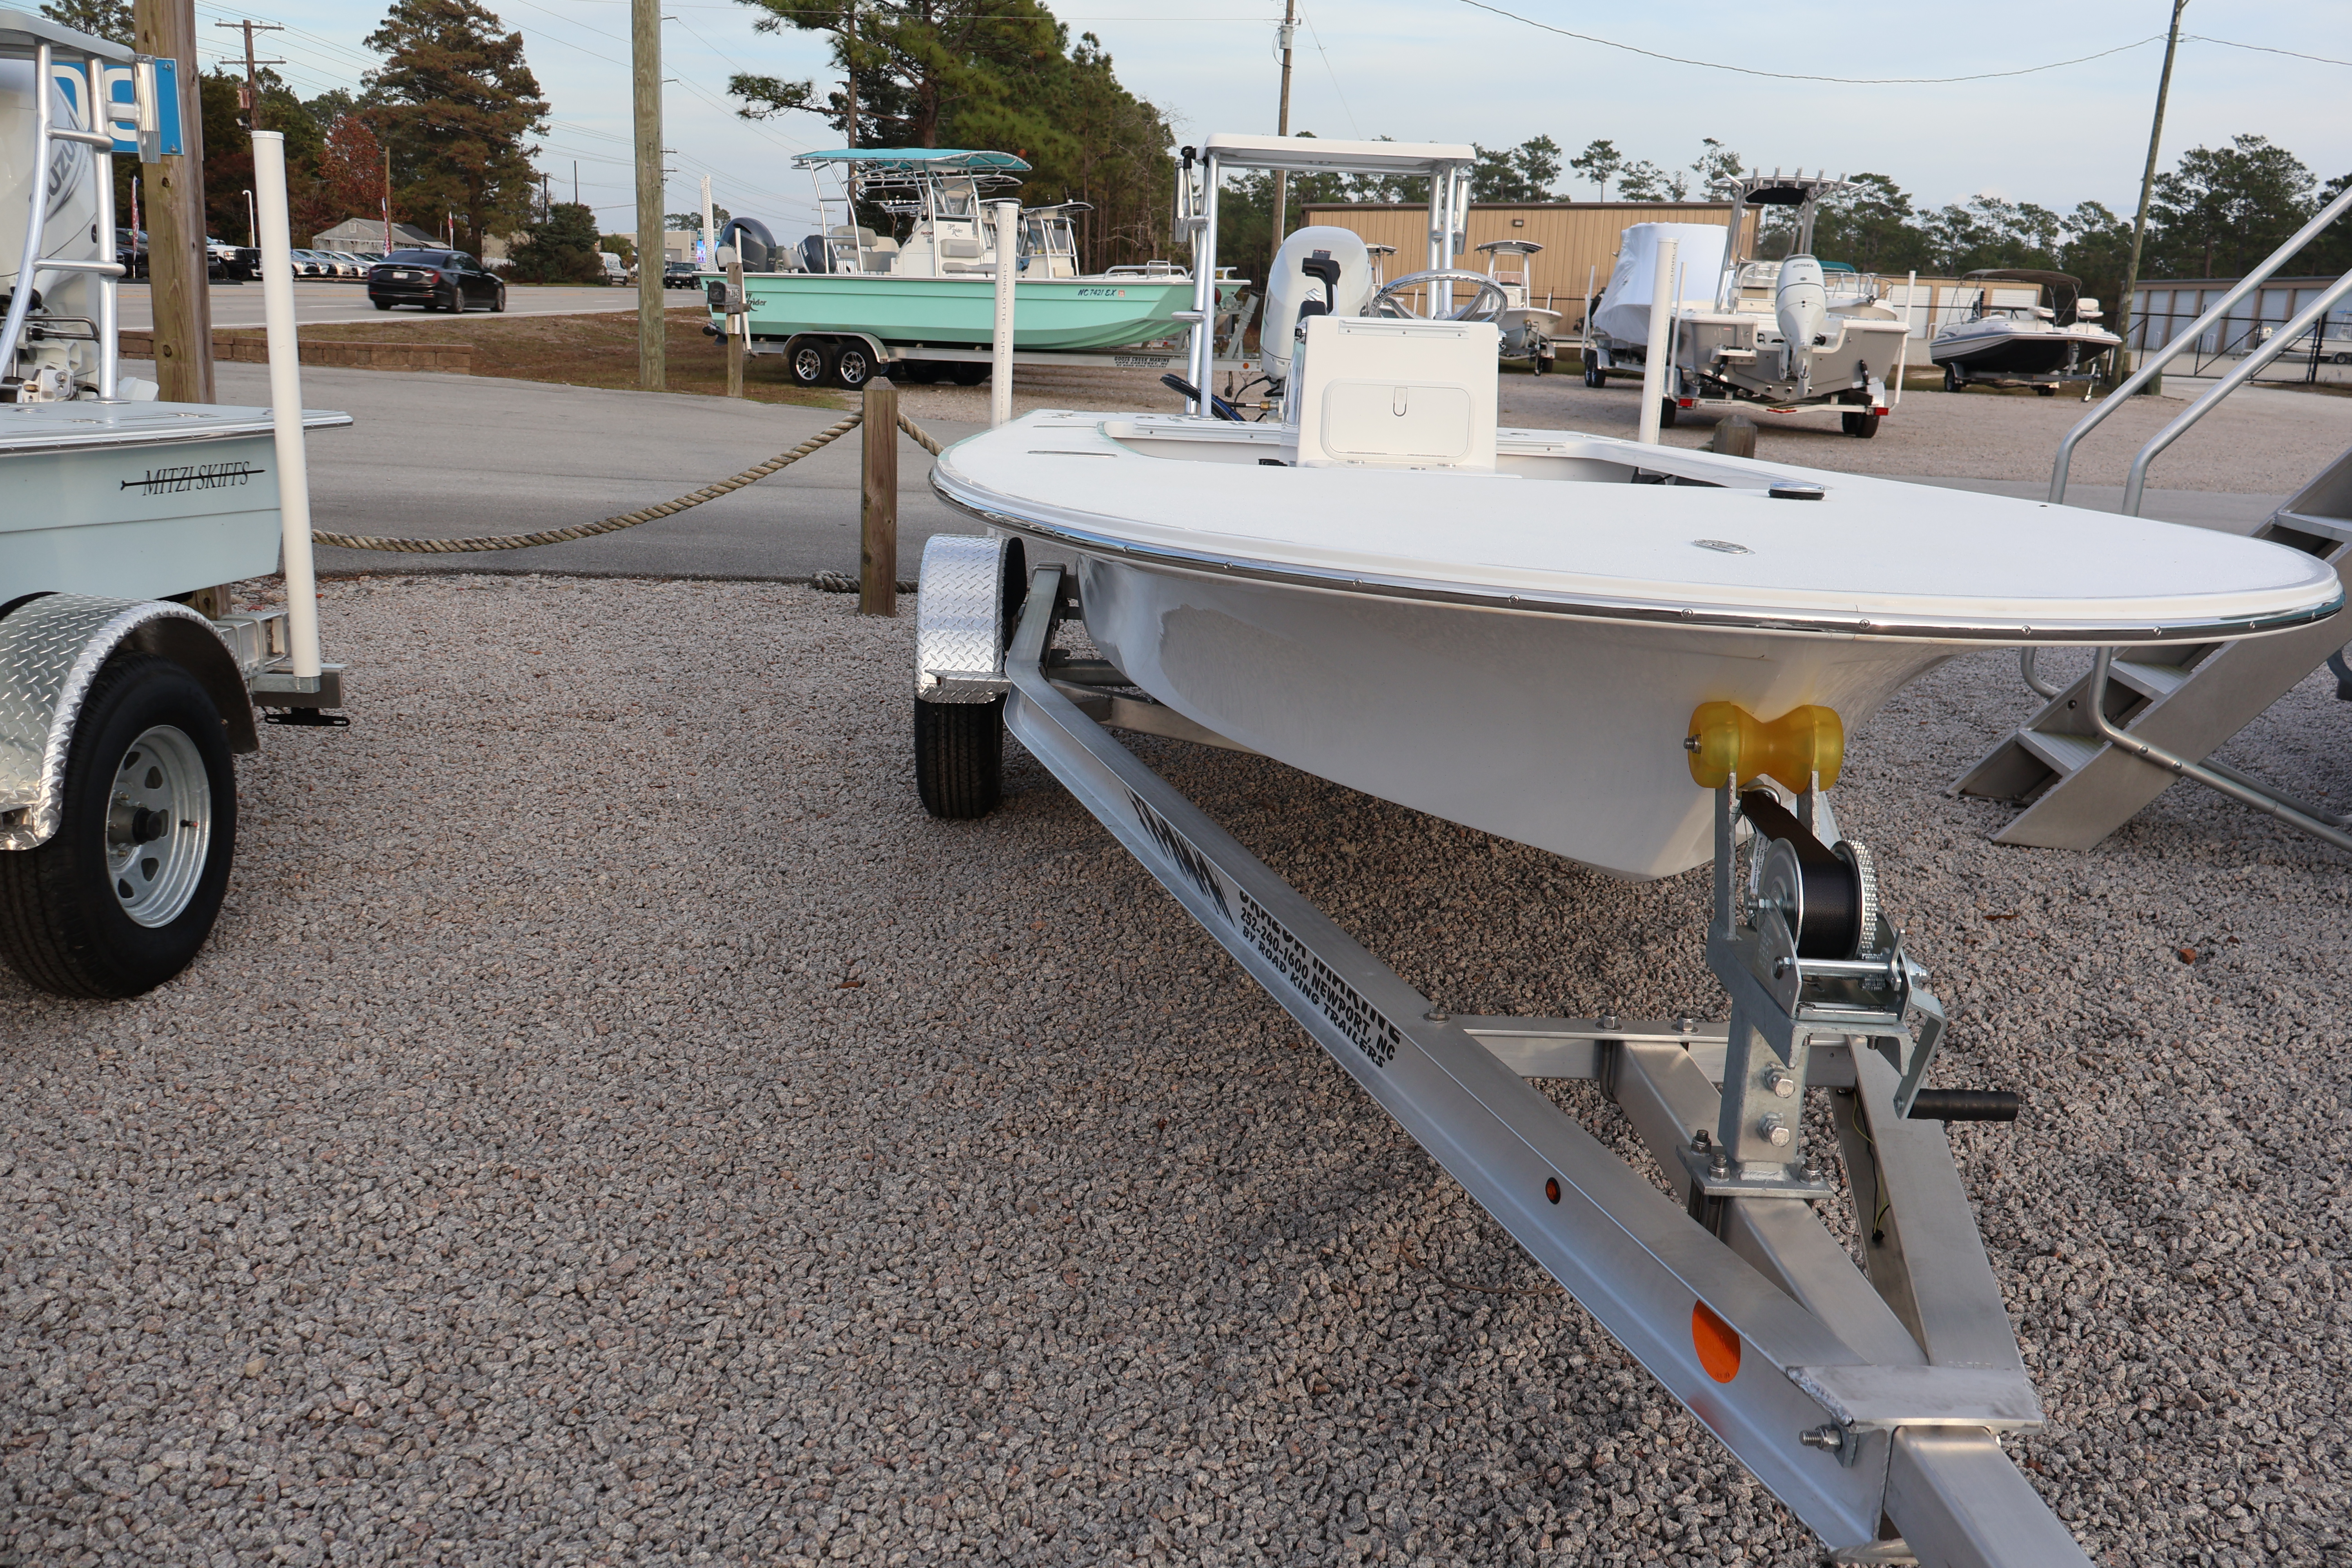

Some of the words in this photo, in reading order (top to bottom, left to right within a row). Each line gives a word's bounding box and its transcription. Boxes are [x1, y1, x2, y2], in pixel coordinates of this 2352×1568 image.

[142, 466, 195, 496] MITZI
[196, 461, 250, 490] SKIFFS
[1240, 907, 1308, 980] 252-240-1600
[1311, 973, 1371, 1043] NEWPORT,
[1376, 1033, 1395, 1061] NC
[1243, 926, 1256, 943] BY
[1258, 940, 1287, 973] ROAD
[1290, 971, 1319, 1005] KING
[1324, 1002, 1386, 1068] TRAILERS
